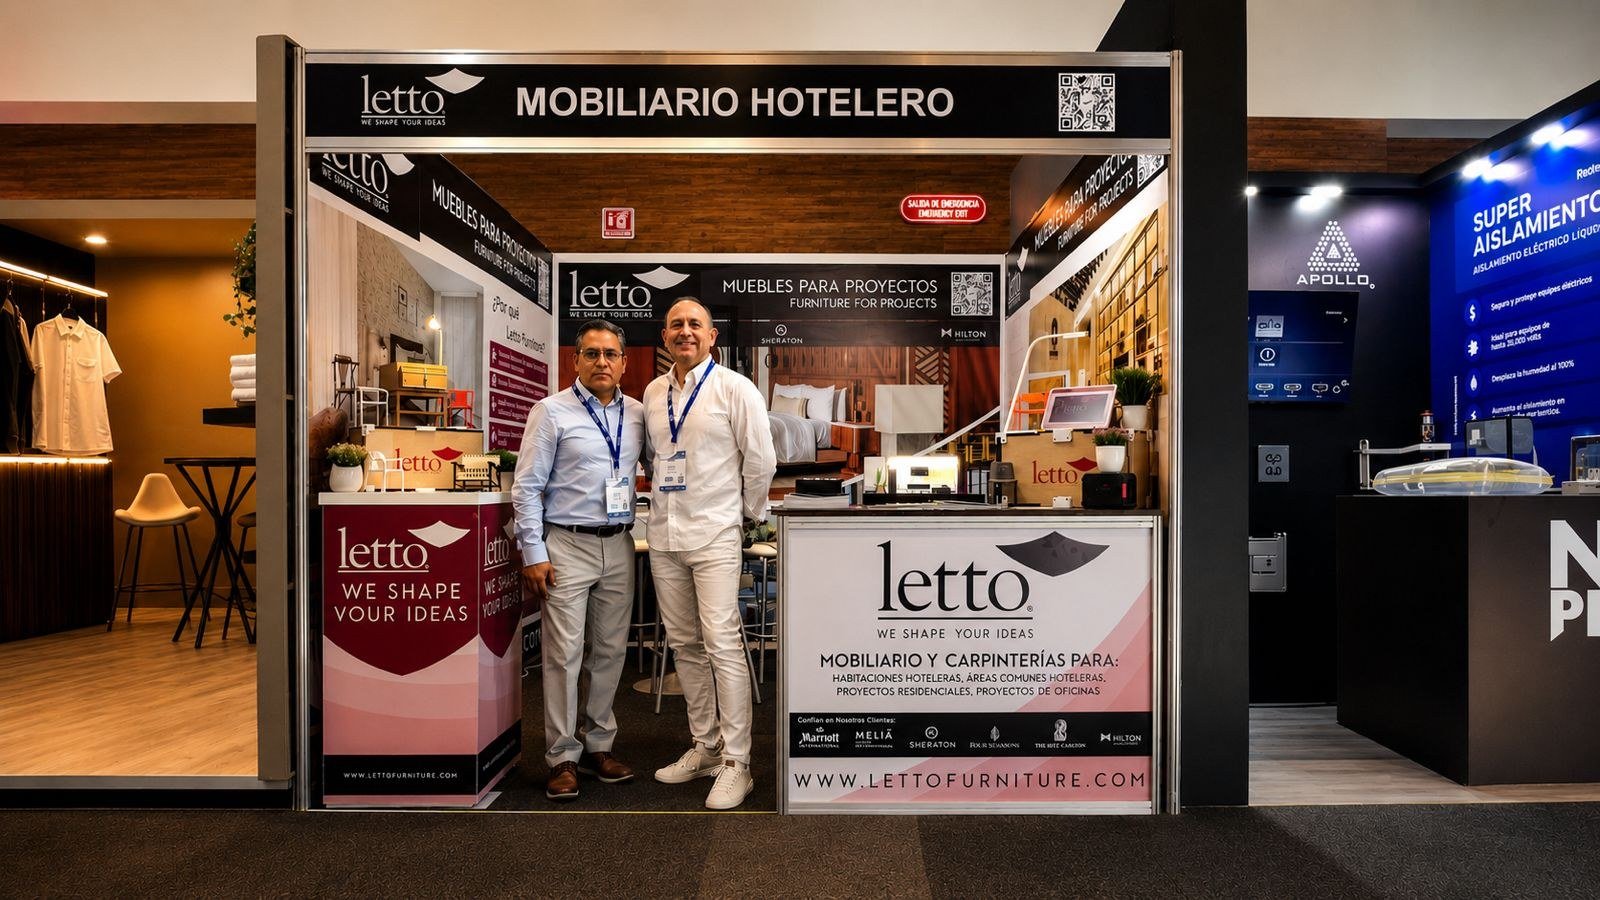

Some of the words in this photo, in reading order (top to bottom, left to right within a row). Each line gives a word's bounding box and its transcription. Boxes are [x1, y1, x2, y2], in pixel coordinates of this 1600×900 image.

[517, 86, 739, 117] MOBILIARIO
[751, 86, 955, 118] HOTELERO
[907, 199, 930, 208] SALIDA
[931, 199, 939, 208] DE
[1084, 202, 1098, 225] FOR
[1098, 167, 1133, 213] PROJECTS
[955, 209, 968, 218] EXIT
[1034, 206, 1064, 252] MUEBLES
[1064, 186, 1084, 222] PARA
[1473, 192, 1532, 233] SUPER
[432, 178, 478, 230] MUEBLES
[479, 214, 501, 247] PARA
[502, 231, 537, 274] PROYECTOS
[474, 239, 503, 270] FURNITURE
[1473, 250, 1522, 276] AISLAMIENTO
[1523, 233, 1570, 260] ELÉCTRICO
[723, 279, 794, 293] MUEBLES
[799, 279, 839, 293] PARA
[845, 279, 938, 294] PROYECTOS
[1296, 274, 1370, 285] APOLLO
[790, 297, 851, 308] FURNITURE
[854, 297, 878, 308] FOR
[880, 297, 937, 308] PROJECTS
[761, 336, 803, 344] SHERATON
[955, 330, 987, 338] HILTON
[395, 448, 441, 472] letto
[1032, 460, 1079, 484] letto
[484, 526, 510, 566] letto
[342, 583, 376, 600] WE
[388, 583, 461, 600] SHAPE
[484, 577, 496, 596] WE
[408, 605, 468, 622] IDEAS
[482, 597, 501, 619] YOUR
[877, 628, 896, 639] WE
[903, 628, 946, 639] SHAPE
[956, 628, 990, 639] YOUR
[997, 628, 1034, 639] IDEAS
[820, 653, 923, 669] MOBILIARIO
[927, 653, 937, 668] Y
[945, 648, 1067, 669] CARPINTERÍAS
[1071, 652, 1119, 668] PARA:
[833, 673, 904, 683] HABITACIONES
[966, 671, 998, 683] ÁREAS
[1000, 673, 1047, 683] COMUNES
[837, 687, 895, 697] PROYECTOS
[976, 686, 1035, 697] PROYECTOS
[1038, 686, 1052, 697] DE
[1054, 686, 1101, 697] OFICINAS
[799, 732, 839, 745] Marriott
[909, 741, 956, 749] SHERATON
[1113, 734, 1142, 742] HILTON
[343, 771, 458, 779] WWW.LETTOFURNITURE.COM
[794, 772, 1145, 789] WWW.LETTOFURNITURE.COM
